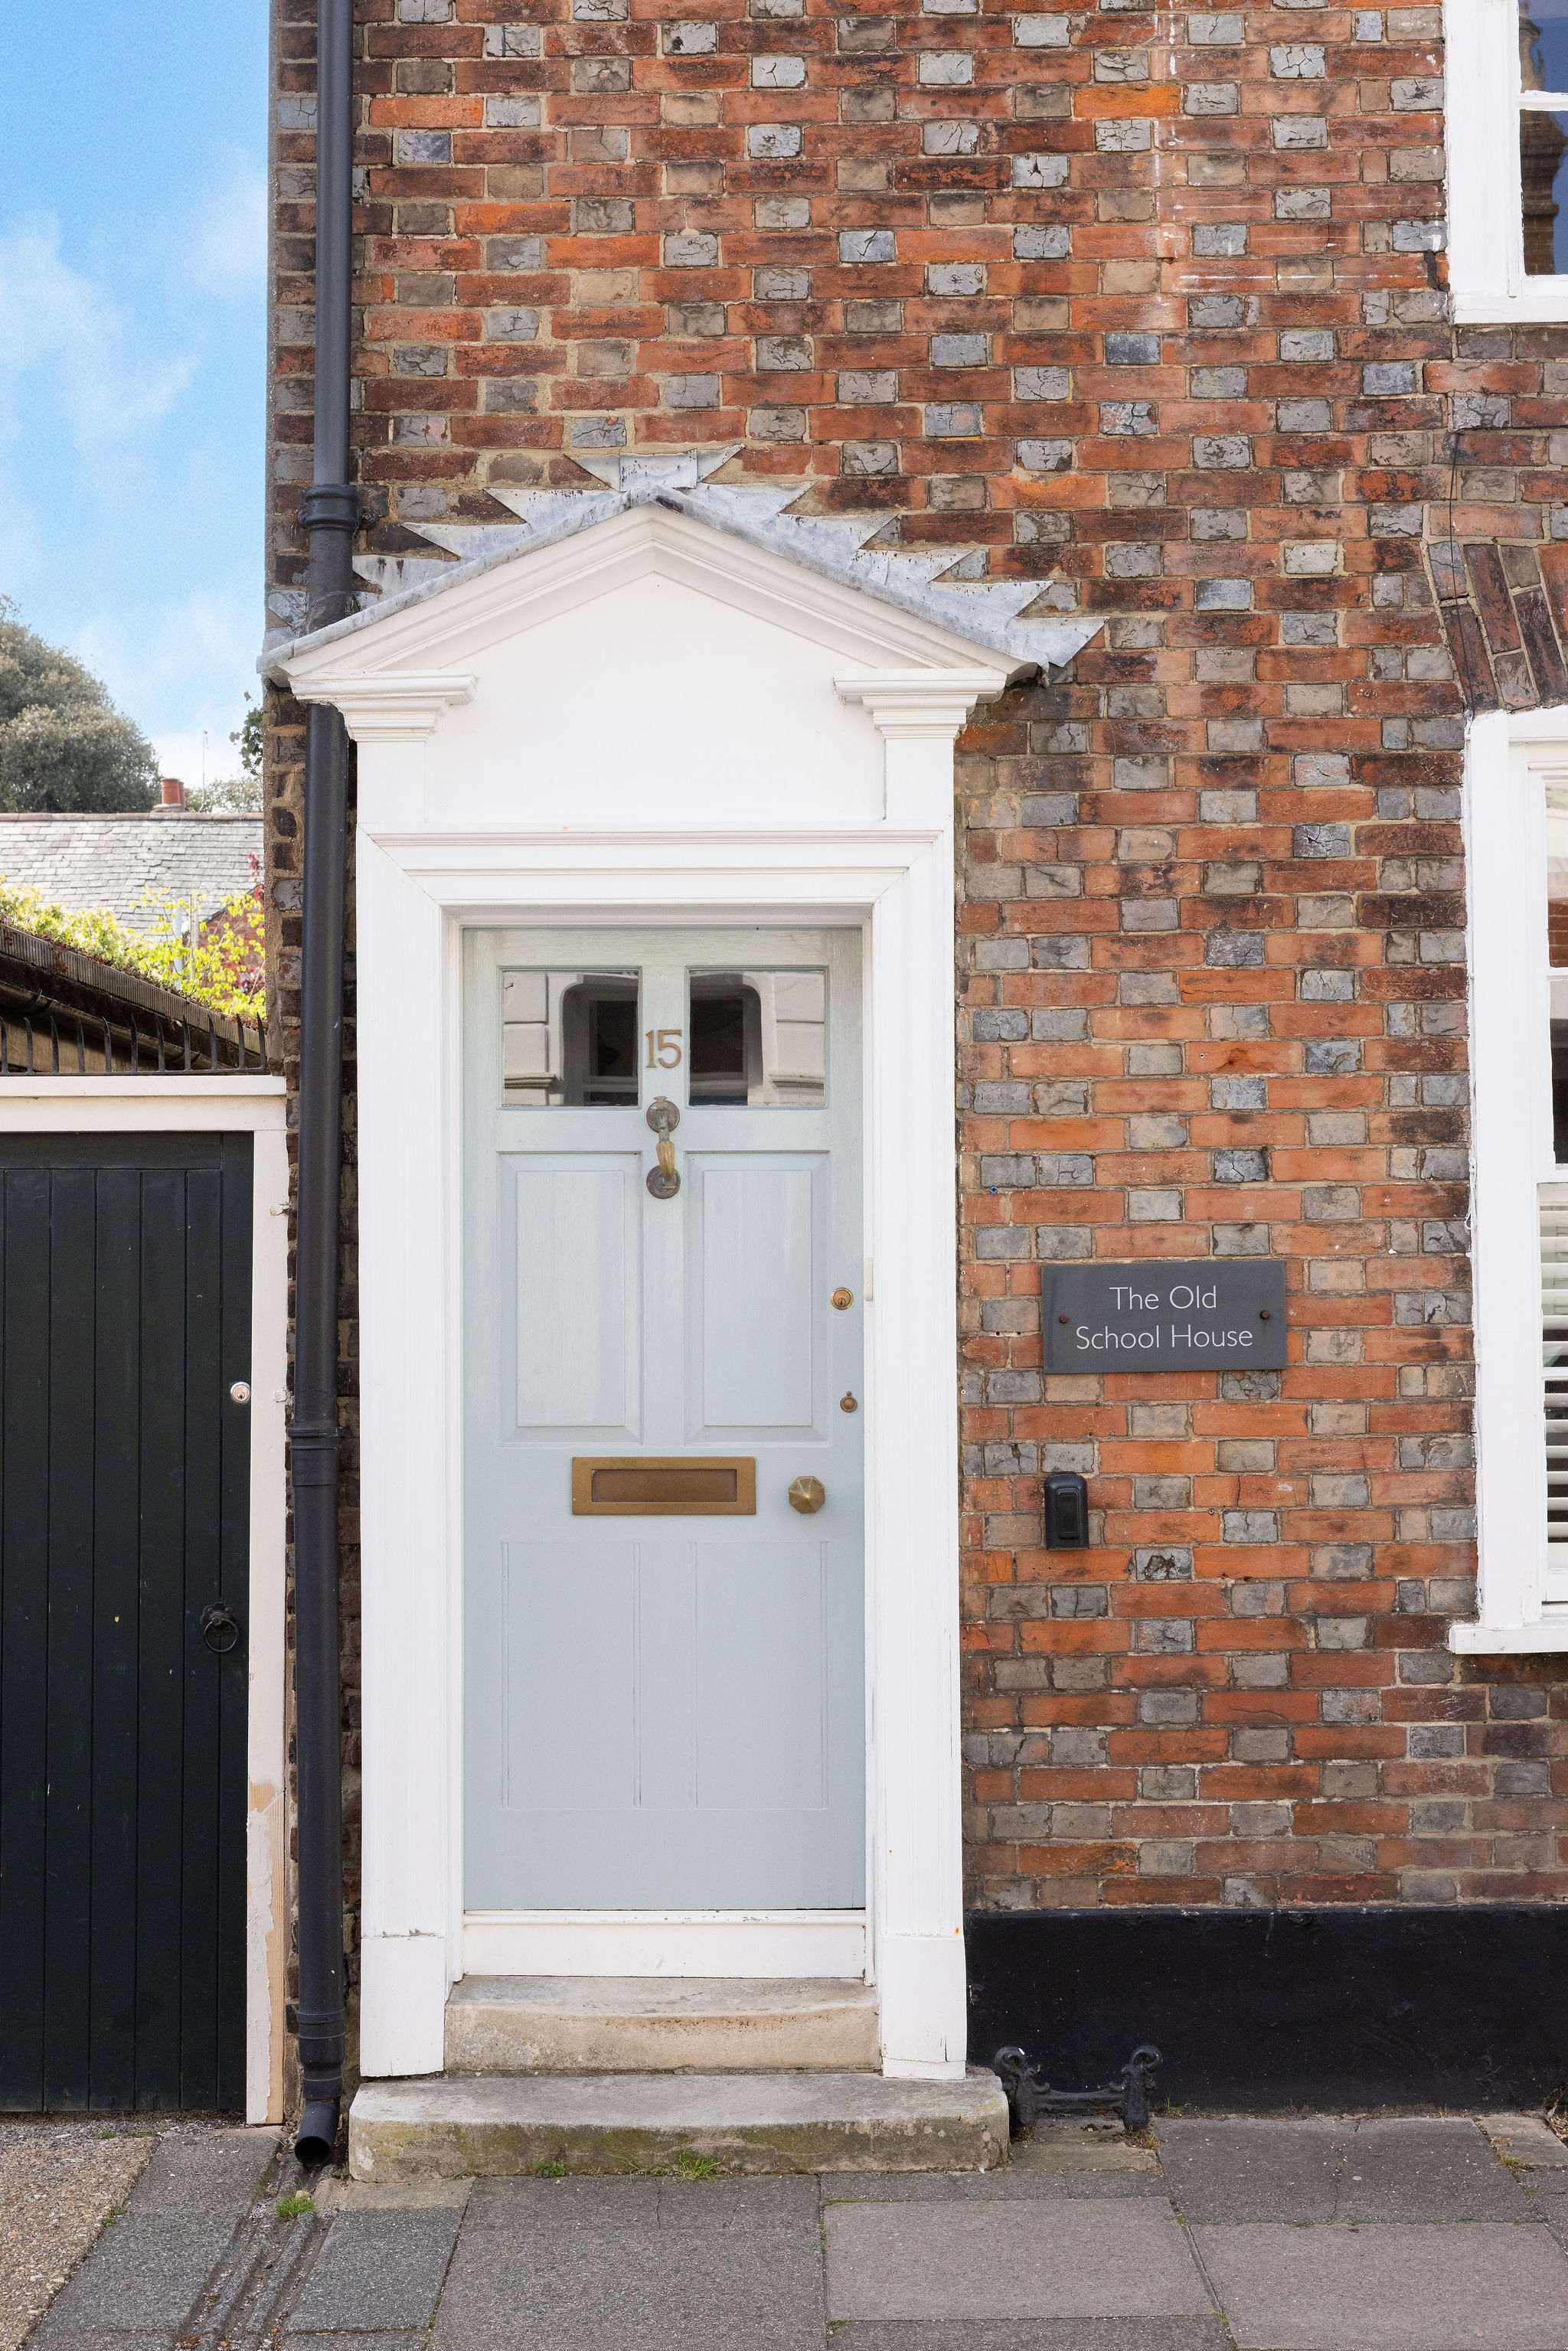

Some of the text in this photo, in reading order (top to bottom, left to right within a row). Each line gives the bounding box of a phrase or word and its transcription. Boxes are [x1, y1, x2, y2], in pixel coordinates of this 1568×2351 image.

[645, 1029, 682, 1069] 15
[1109, 1285, 1217, 1310] The Old
[1076, 1324, 1253, 1350] School House
